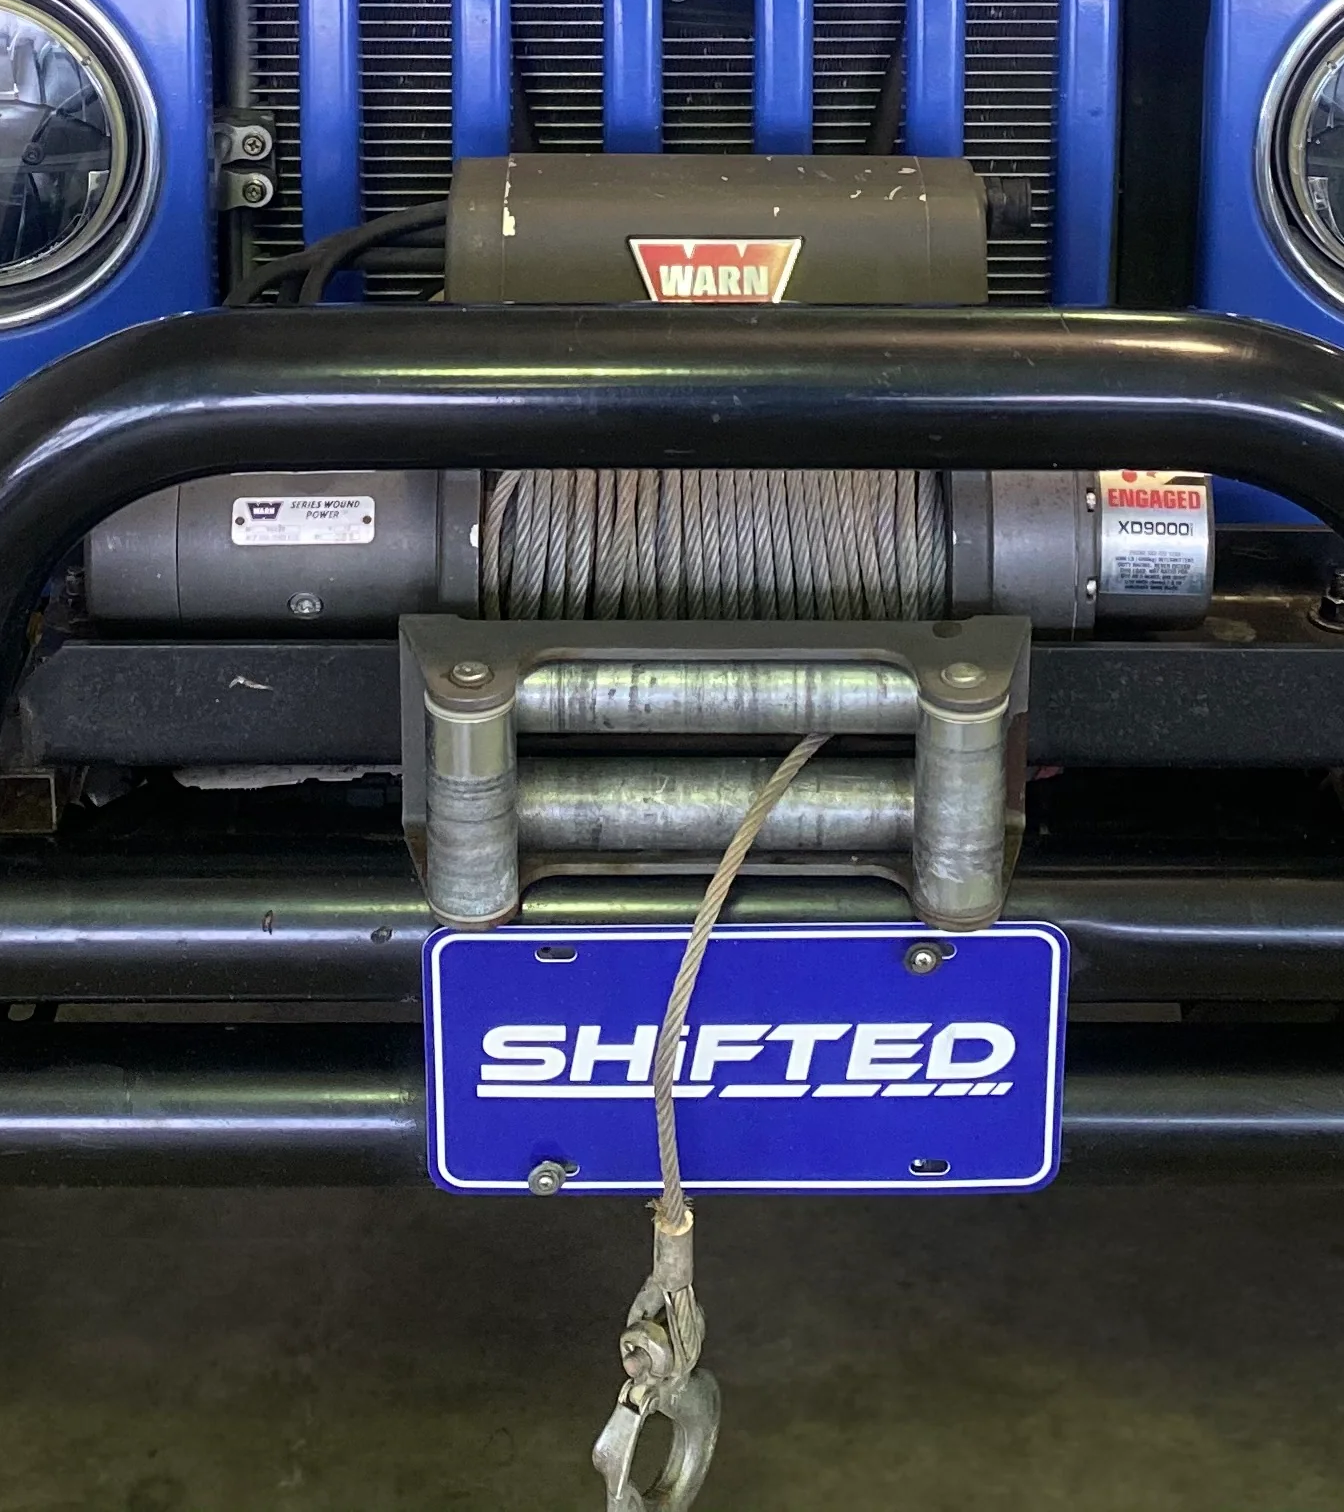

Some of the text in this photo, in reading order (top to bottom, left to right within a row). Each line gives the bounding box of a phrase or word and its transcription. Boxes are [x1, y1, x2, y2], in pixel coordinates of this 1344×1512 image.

[659, 265, 769, 296] WARN
[290, 500, 361, 509] SERIES WOUND
[1107, 488, 1201, 509] ENGAGED
[305, 510, 340, 520] POWER
